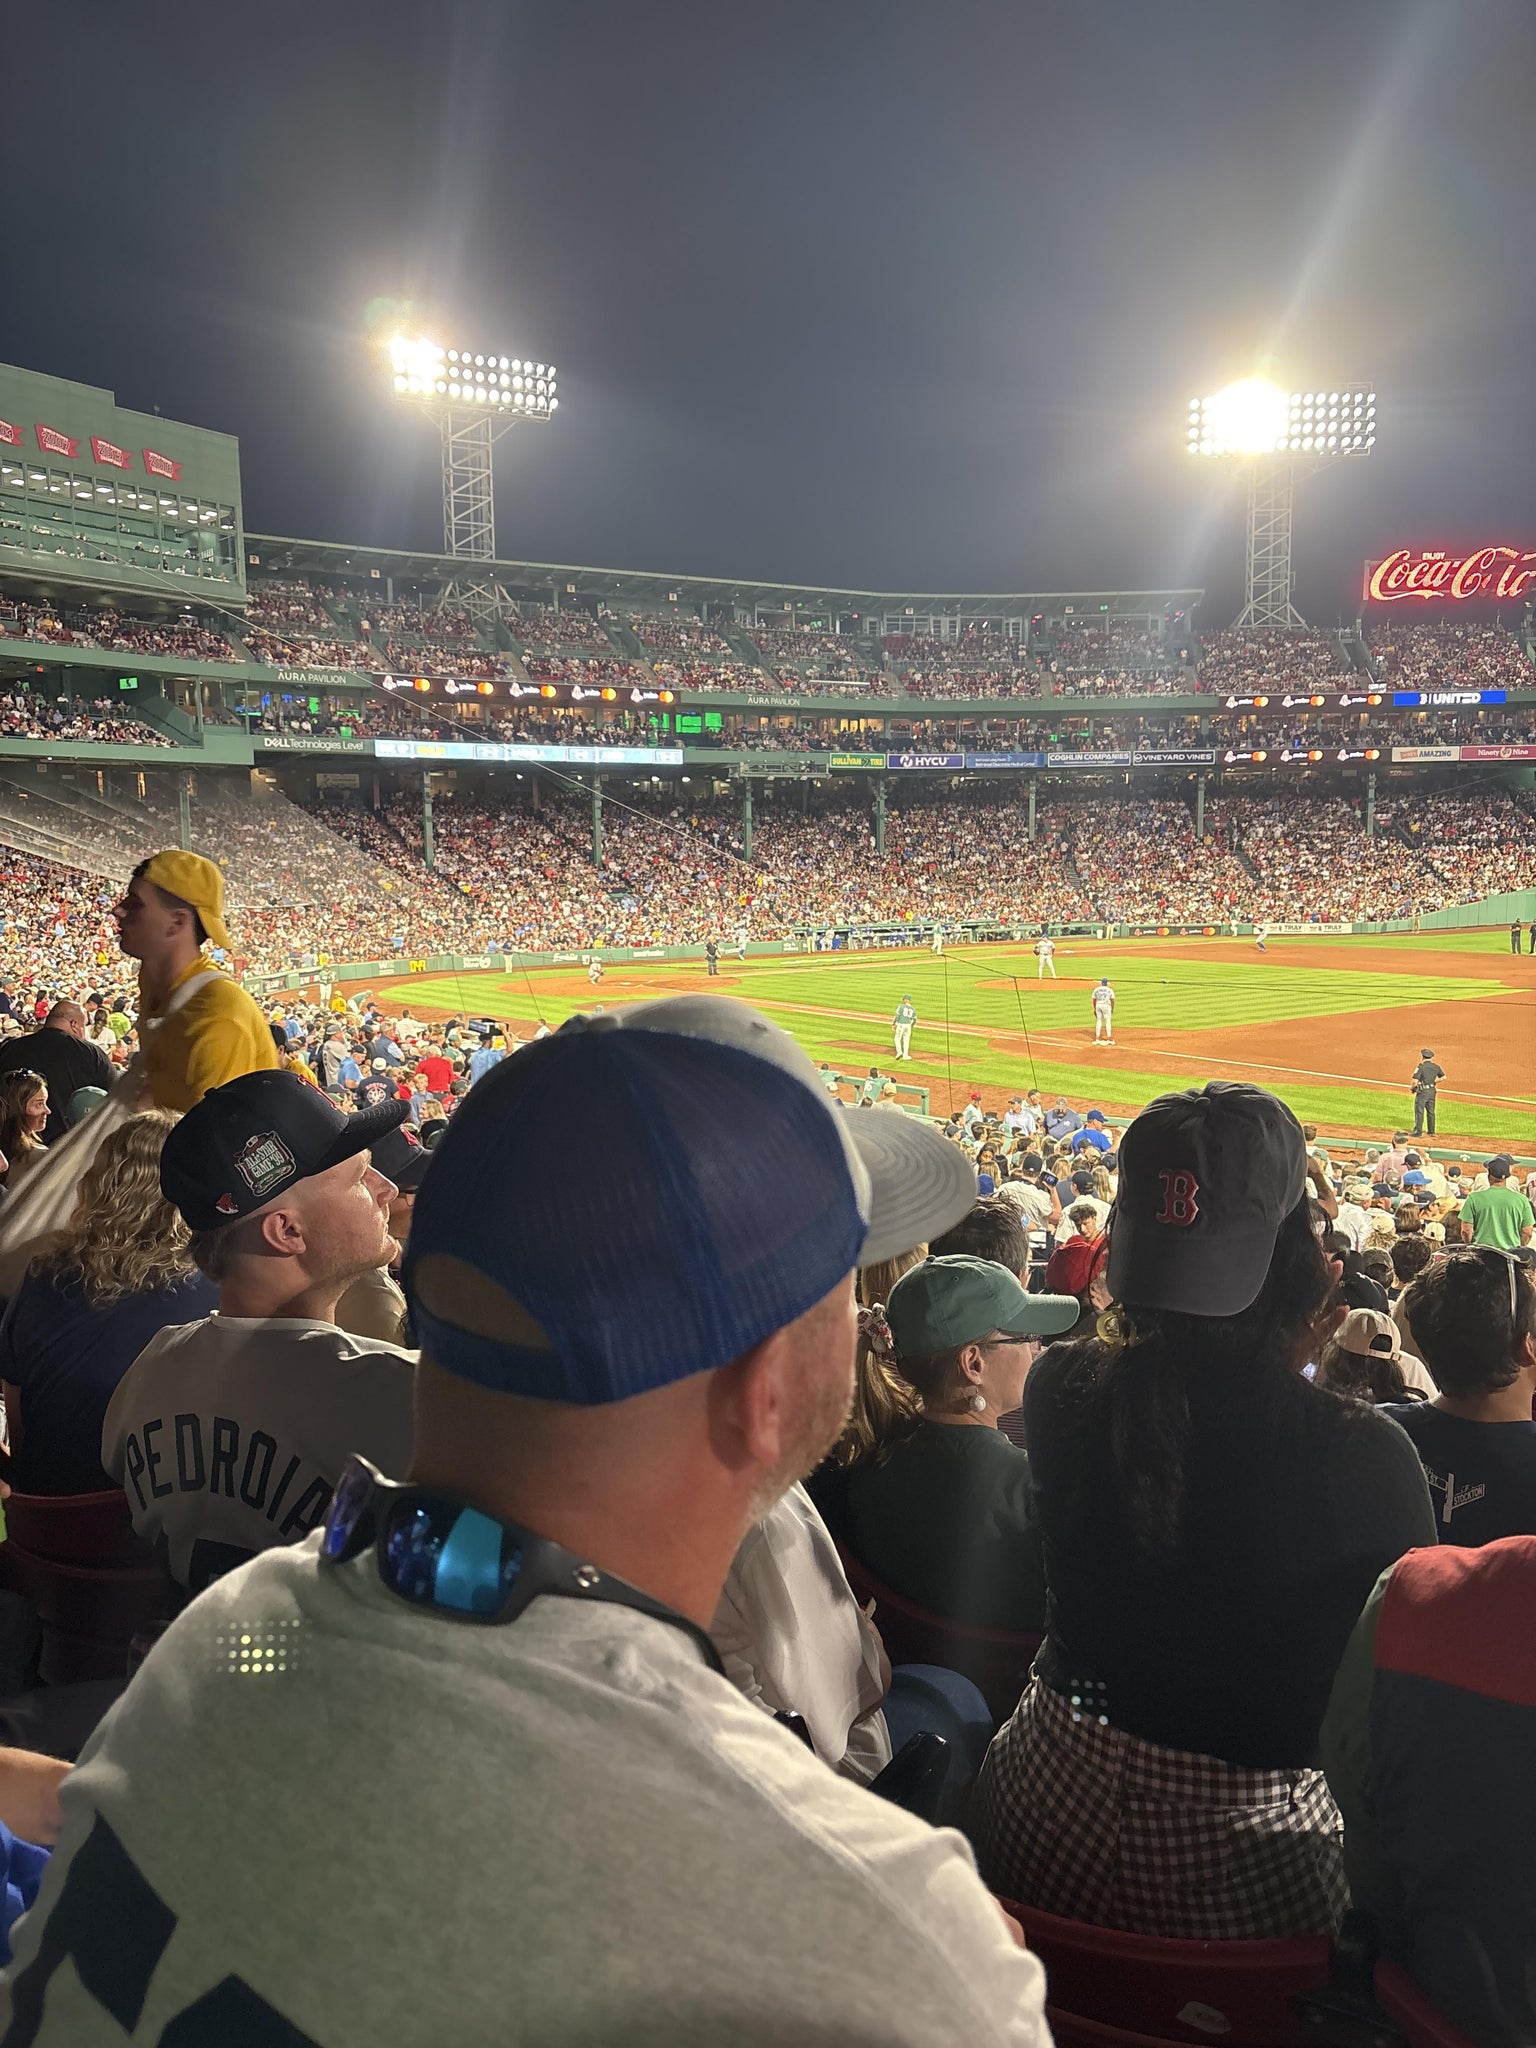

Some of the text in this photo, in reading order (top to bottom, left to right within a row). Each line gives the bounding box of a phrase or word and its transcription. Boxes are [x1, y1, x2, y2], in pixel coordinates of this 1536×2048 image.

[1422, 552, 1445, 560] ENJOY
[1370, 547, 1536, 600] Coca-Cla
[307, 672, 347, 684] PAVILION
[770, 697, 800, 706] PAVILION
[1433, 693, 1481, 704] UNITED
[264, 737, 290, 748] DELL
[290, 738, 342, 751] Technologies
[343, 741, 364, 750] Level
[1419, 750, 1451, 758] AMAZING
[1478, 748, 1528, 757] Ninety Nine
[832, 757, 883, 766] SULLIVAN TIRE
[915, 756, 947, 766] HYCU
[903, 1008, 914, 1017] 83
[244, 1140, 278, 1169] ALL-STAR
[251, 1159, 275, 1178] GAME
[1156, 1168, 1199, 1226] B
[127, 1413, 335, 1537] PEDROIA
